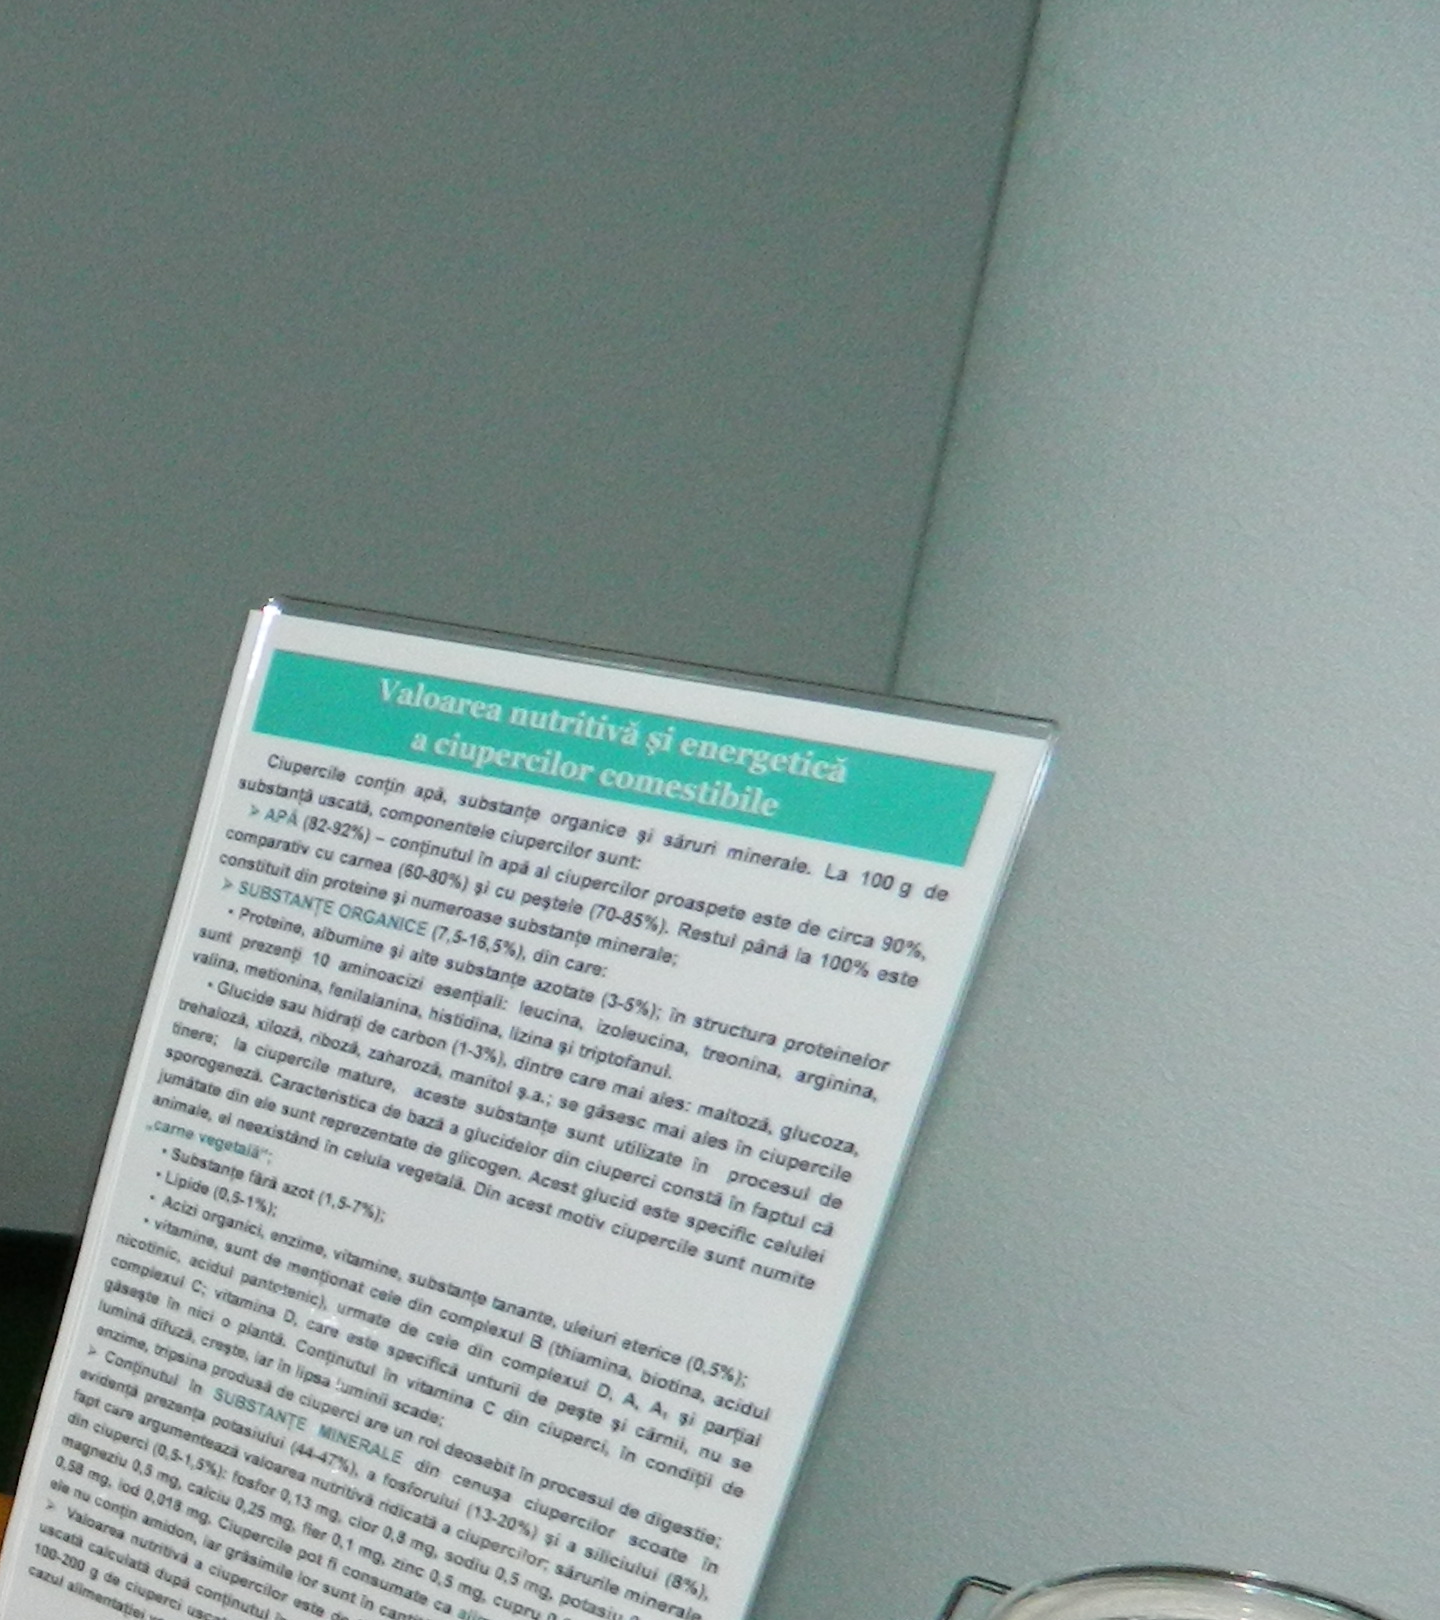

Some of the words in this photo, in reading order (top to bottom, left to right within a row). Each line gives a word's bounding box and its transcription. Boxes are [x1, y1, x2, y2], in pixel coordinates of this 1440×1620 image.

[381, 678, 503, 723] Valoarea
[507, 707, 640, 747] nutritivă
[678, 737, 848, 784] energetică
[410, 733, 428, 753] a
[433, 732, 596, 782] ciupercilor
[598, 768, 780, 818] comestibile
